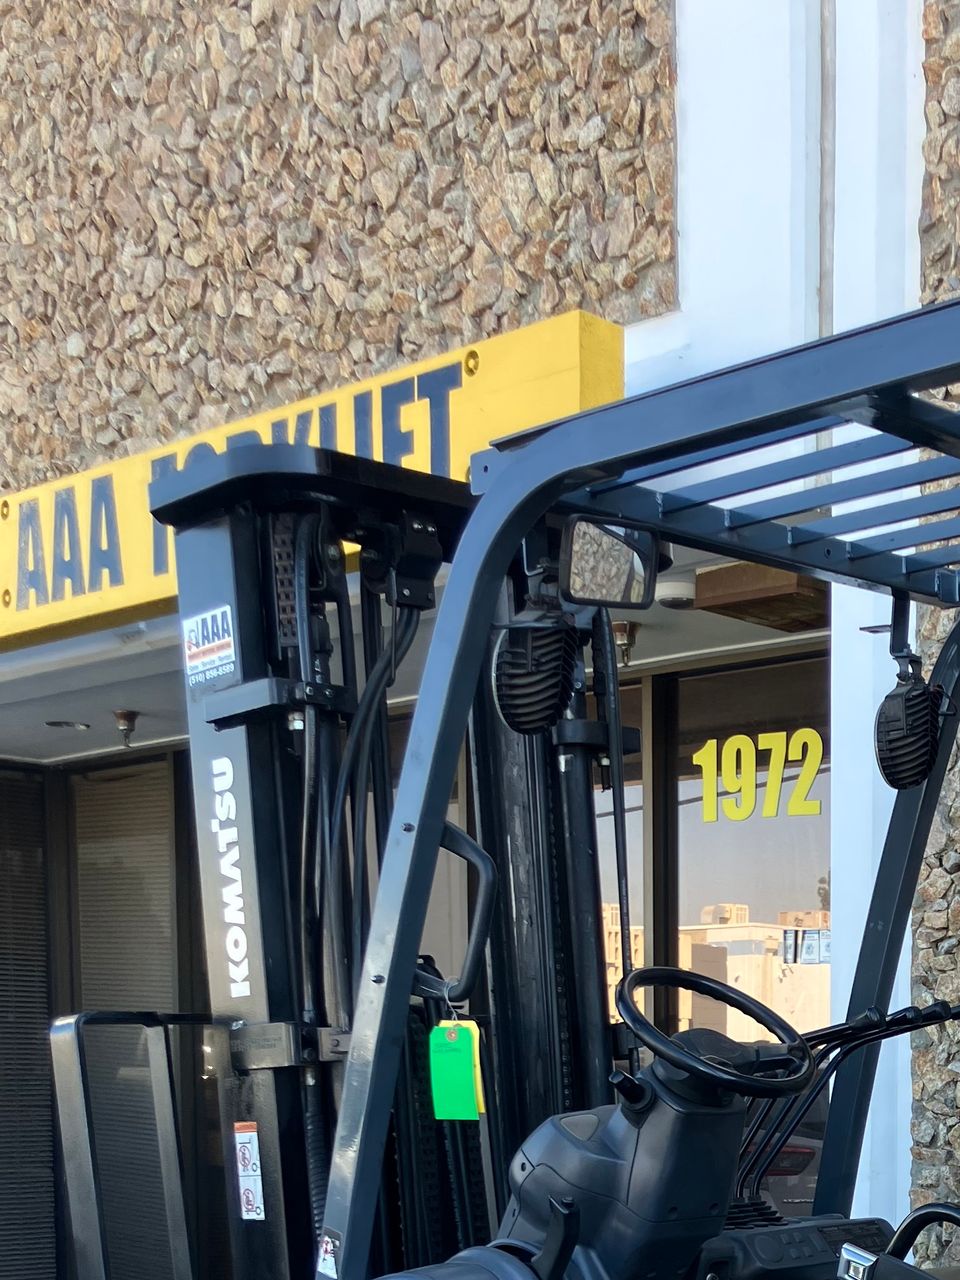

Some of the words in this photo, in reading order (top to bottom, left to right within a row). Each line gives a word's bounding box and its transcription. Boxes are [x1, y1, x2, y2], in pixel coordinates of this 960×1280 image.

[16, 474, 125, 611] AAA
[201, 610, 231, 647] AAA
[189, 672, 205, 687] (510)
[692, 727, 823, 823] 1972
[211, 756, 251, 998] KOMATSU
